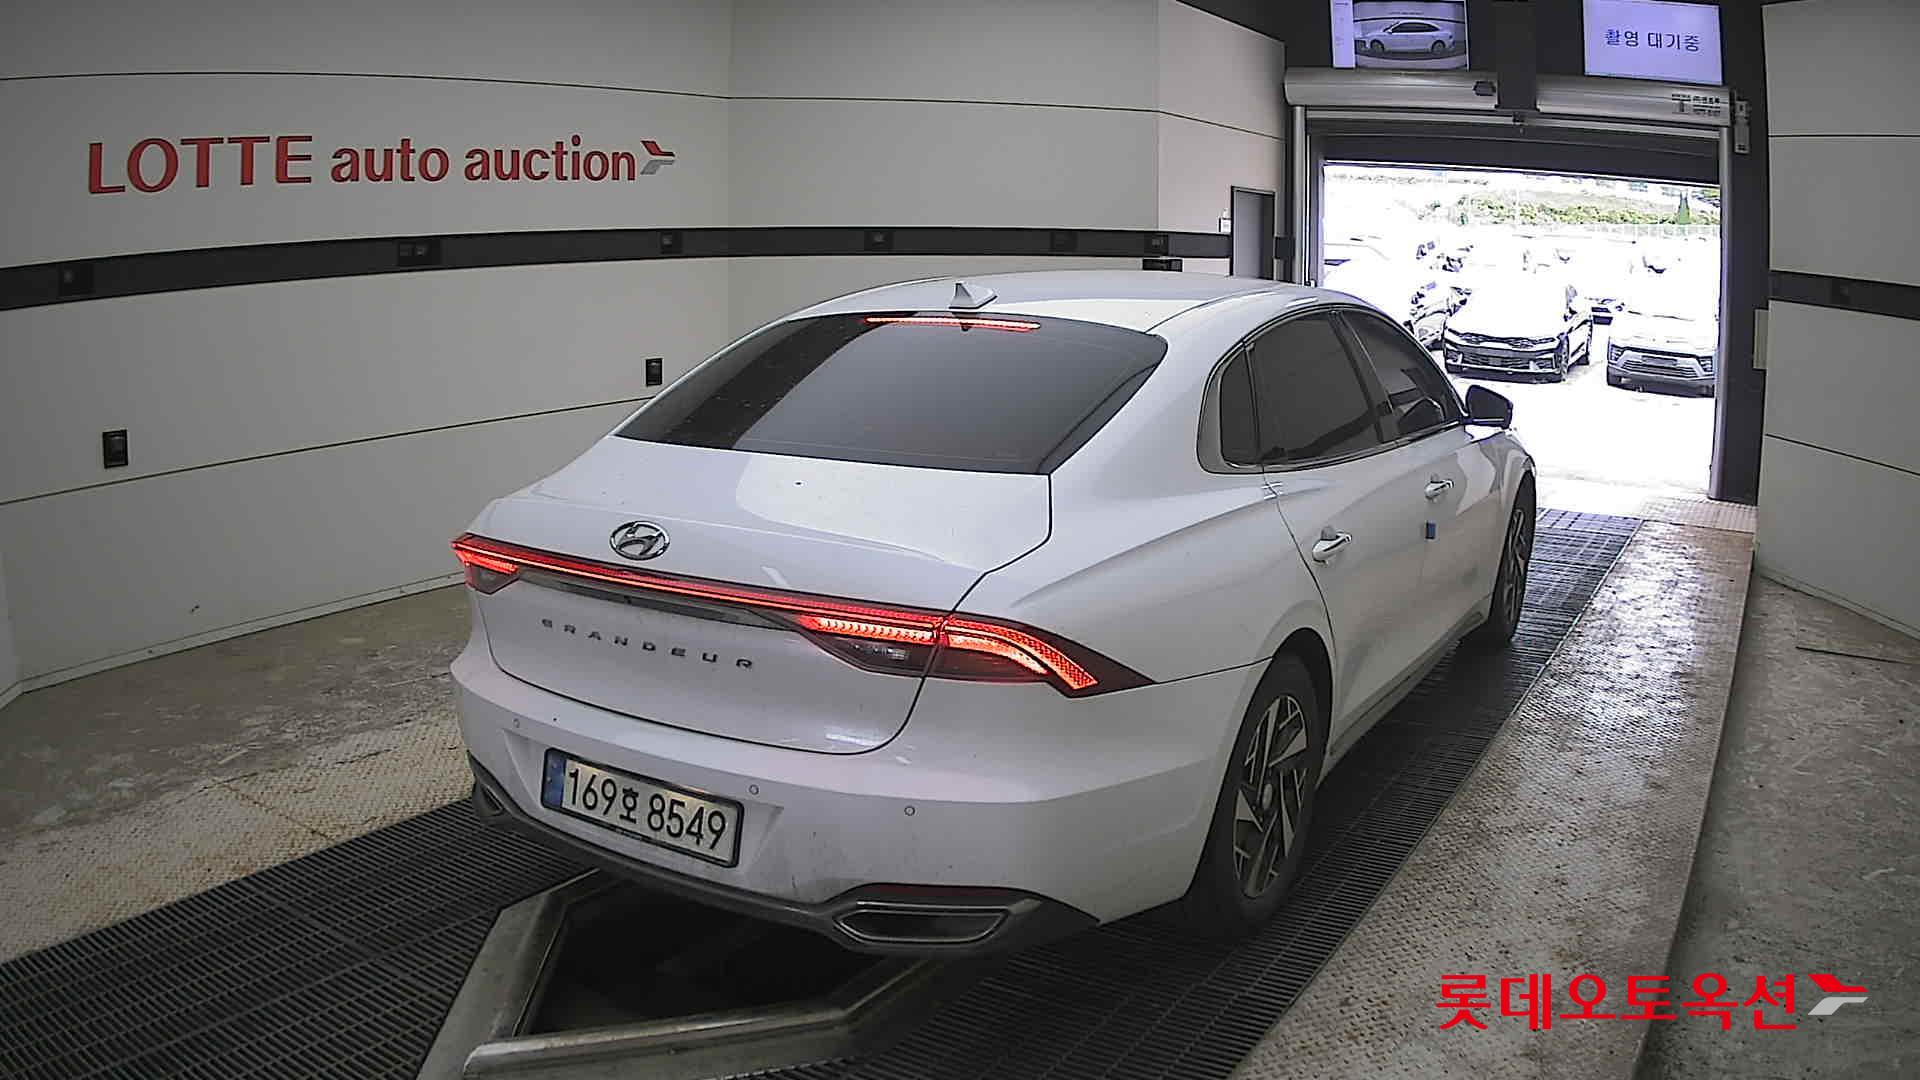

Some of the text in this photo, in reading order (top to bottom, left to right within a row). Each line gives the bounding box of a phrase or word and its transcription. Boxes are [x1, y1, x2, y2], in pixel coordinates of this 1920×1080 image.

[1605, 29, 1700, 52] 촬영 대기중
[87, 134, 637, 194] LOTTE auto auction
[541, 618, 753, 669] GRANDEUR
[567, 767, 727, 851] 169호 8549
